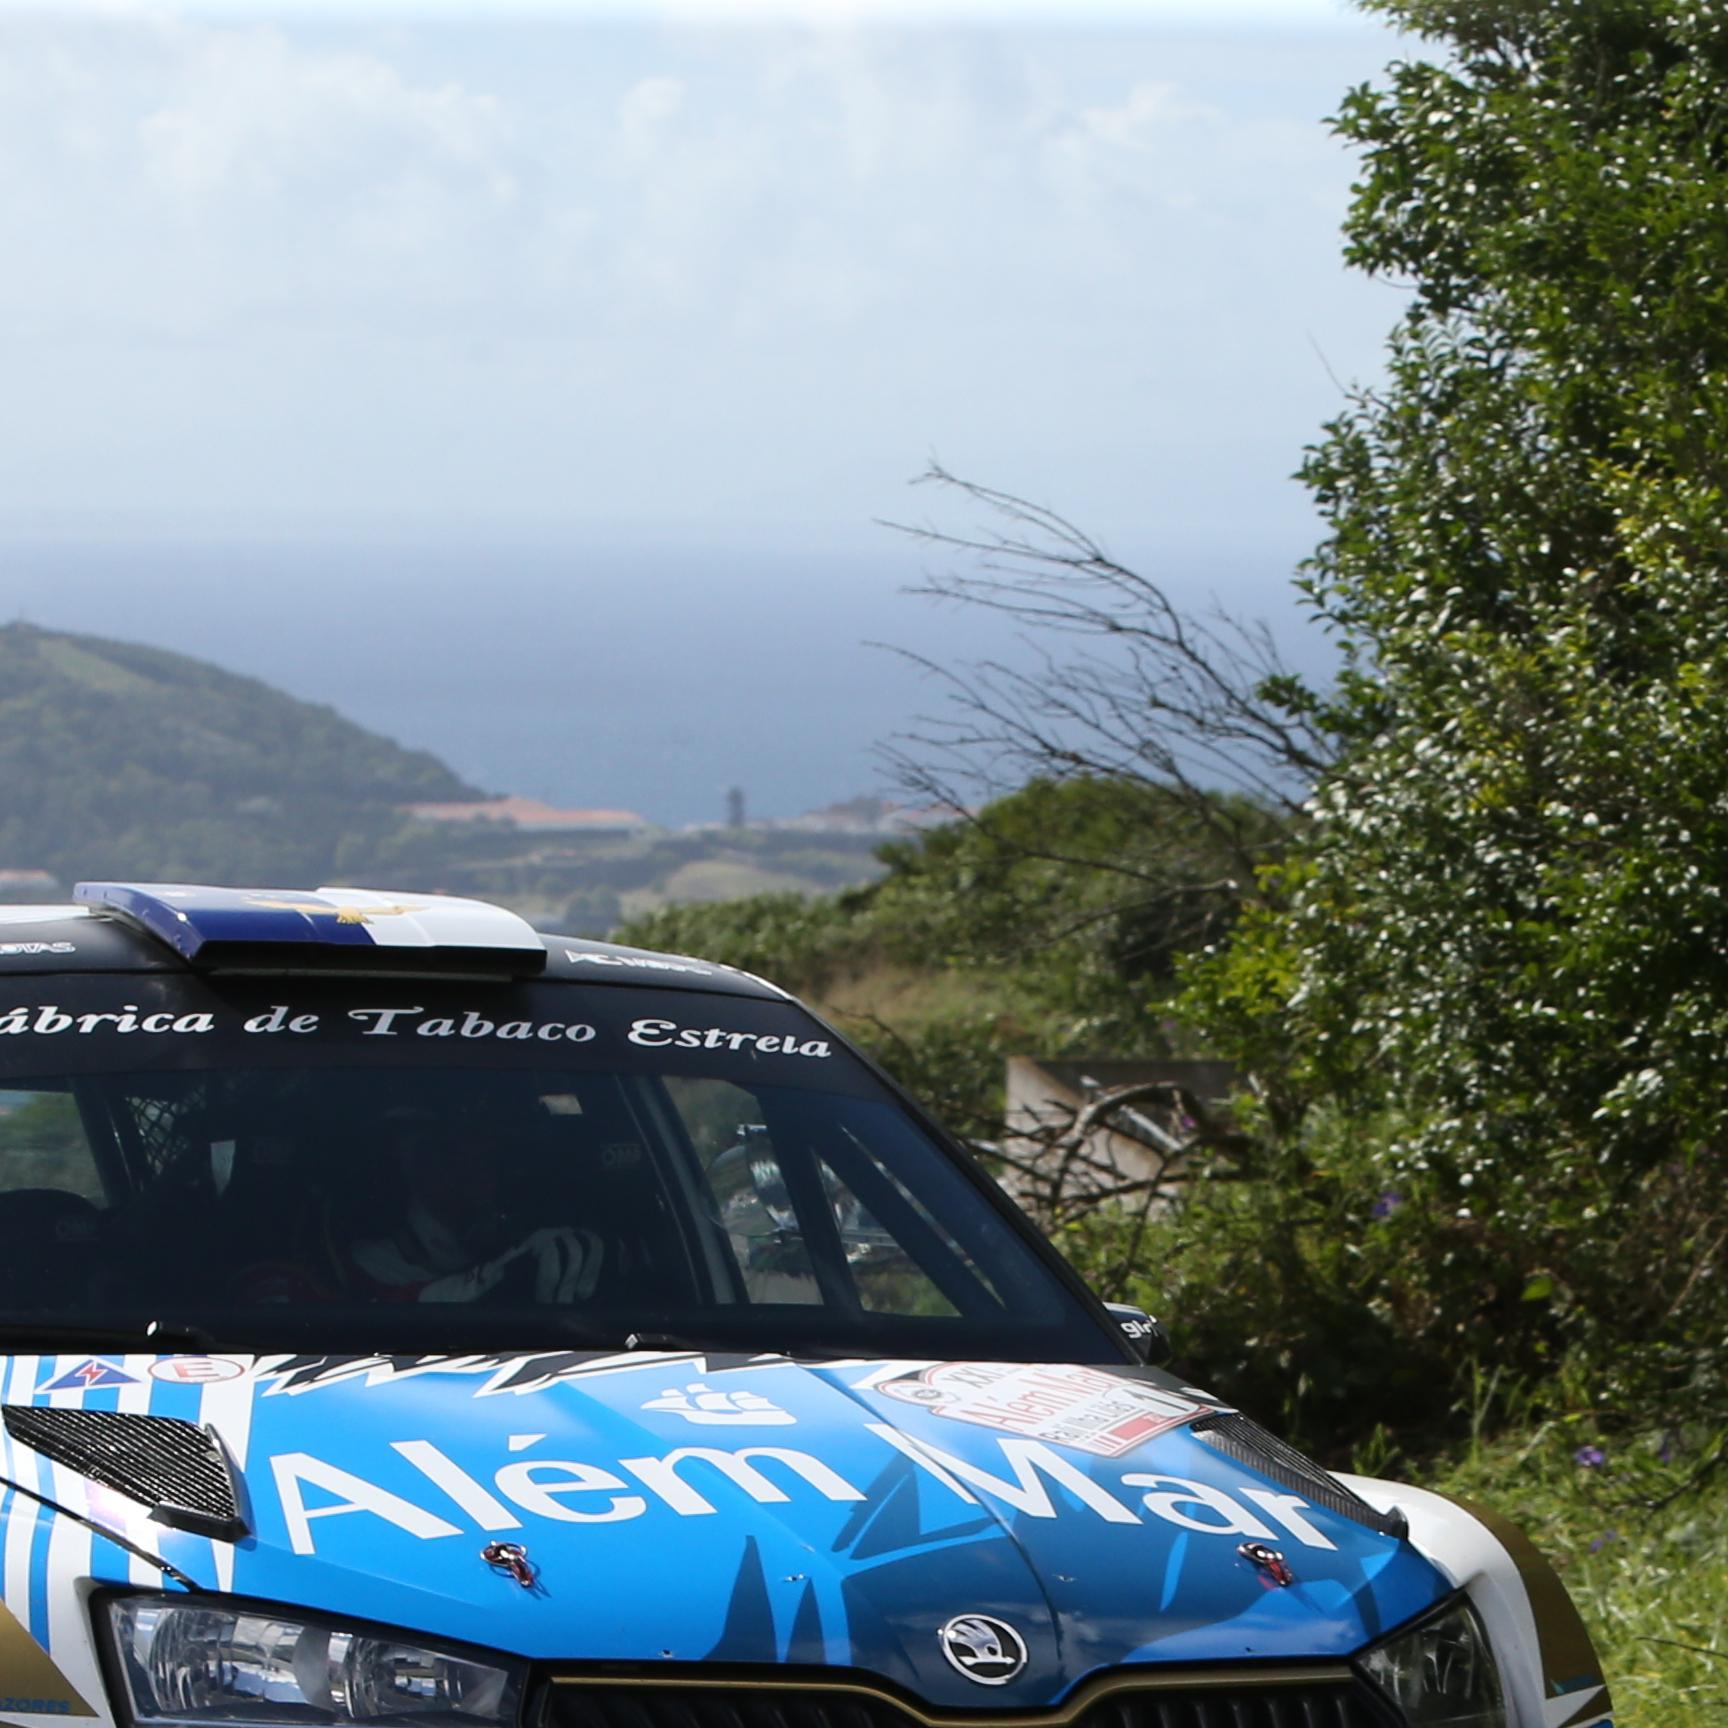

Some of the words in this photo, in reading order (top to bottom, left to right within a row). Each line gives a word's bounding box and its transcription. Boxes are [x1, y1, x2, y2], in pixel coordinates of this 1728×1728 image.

[243, 1005, 320, 1034] de
[348, 1006, 596, 1043] Tabaco
[627, 1019, 832, 1058] Estrela
[269, 1433, 868, 1556] Além
[863, 1421, 1339, 1551] Mar
